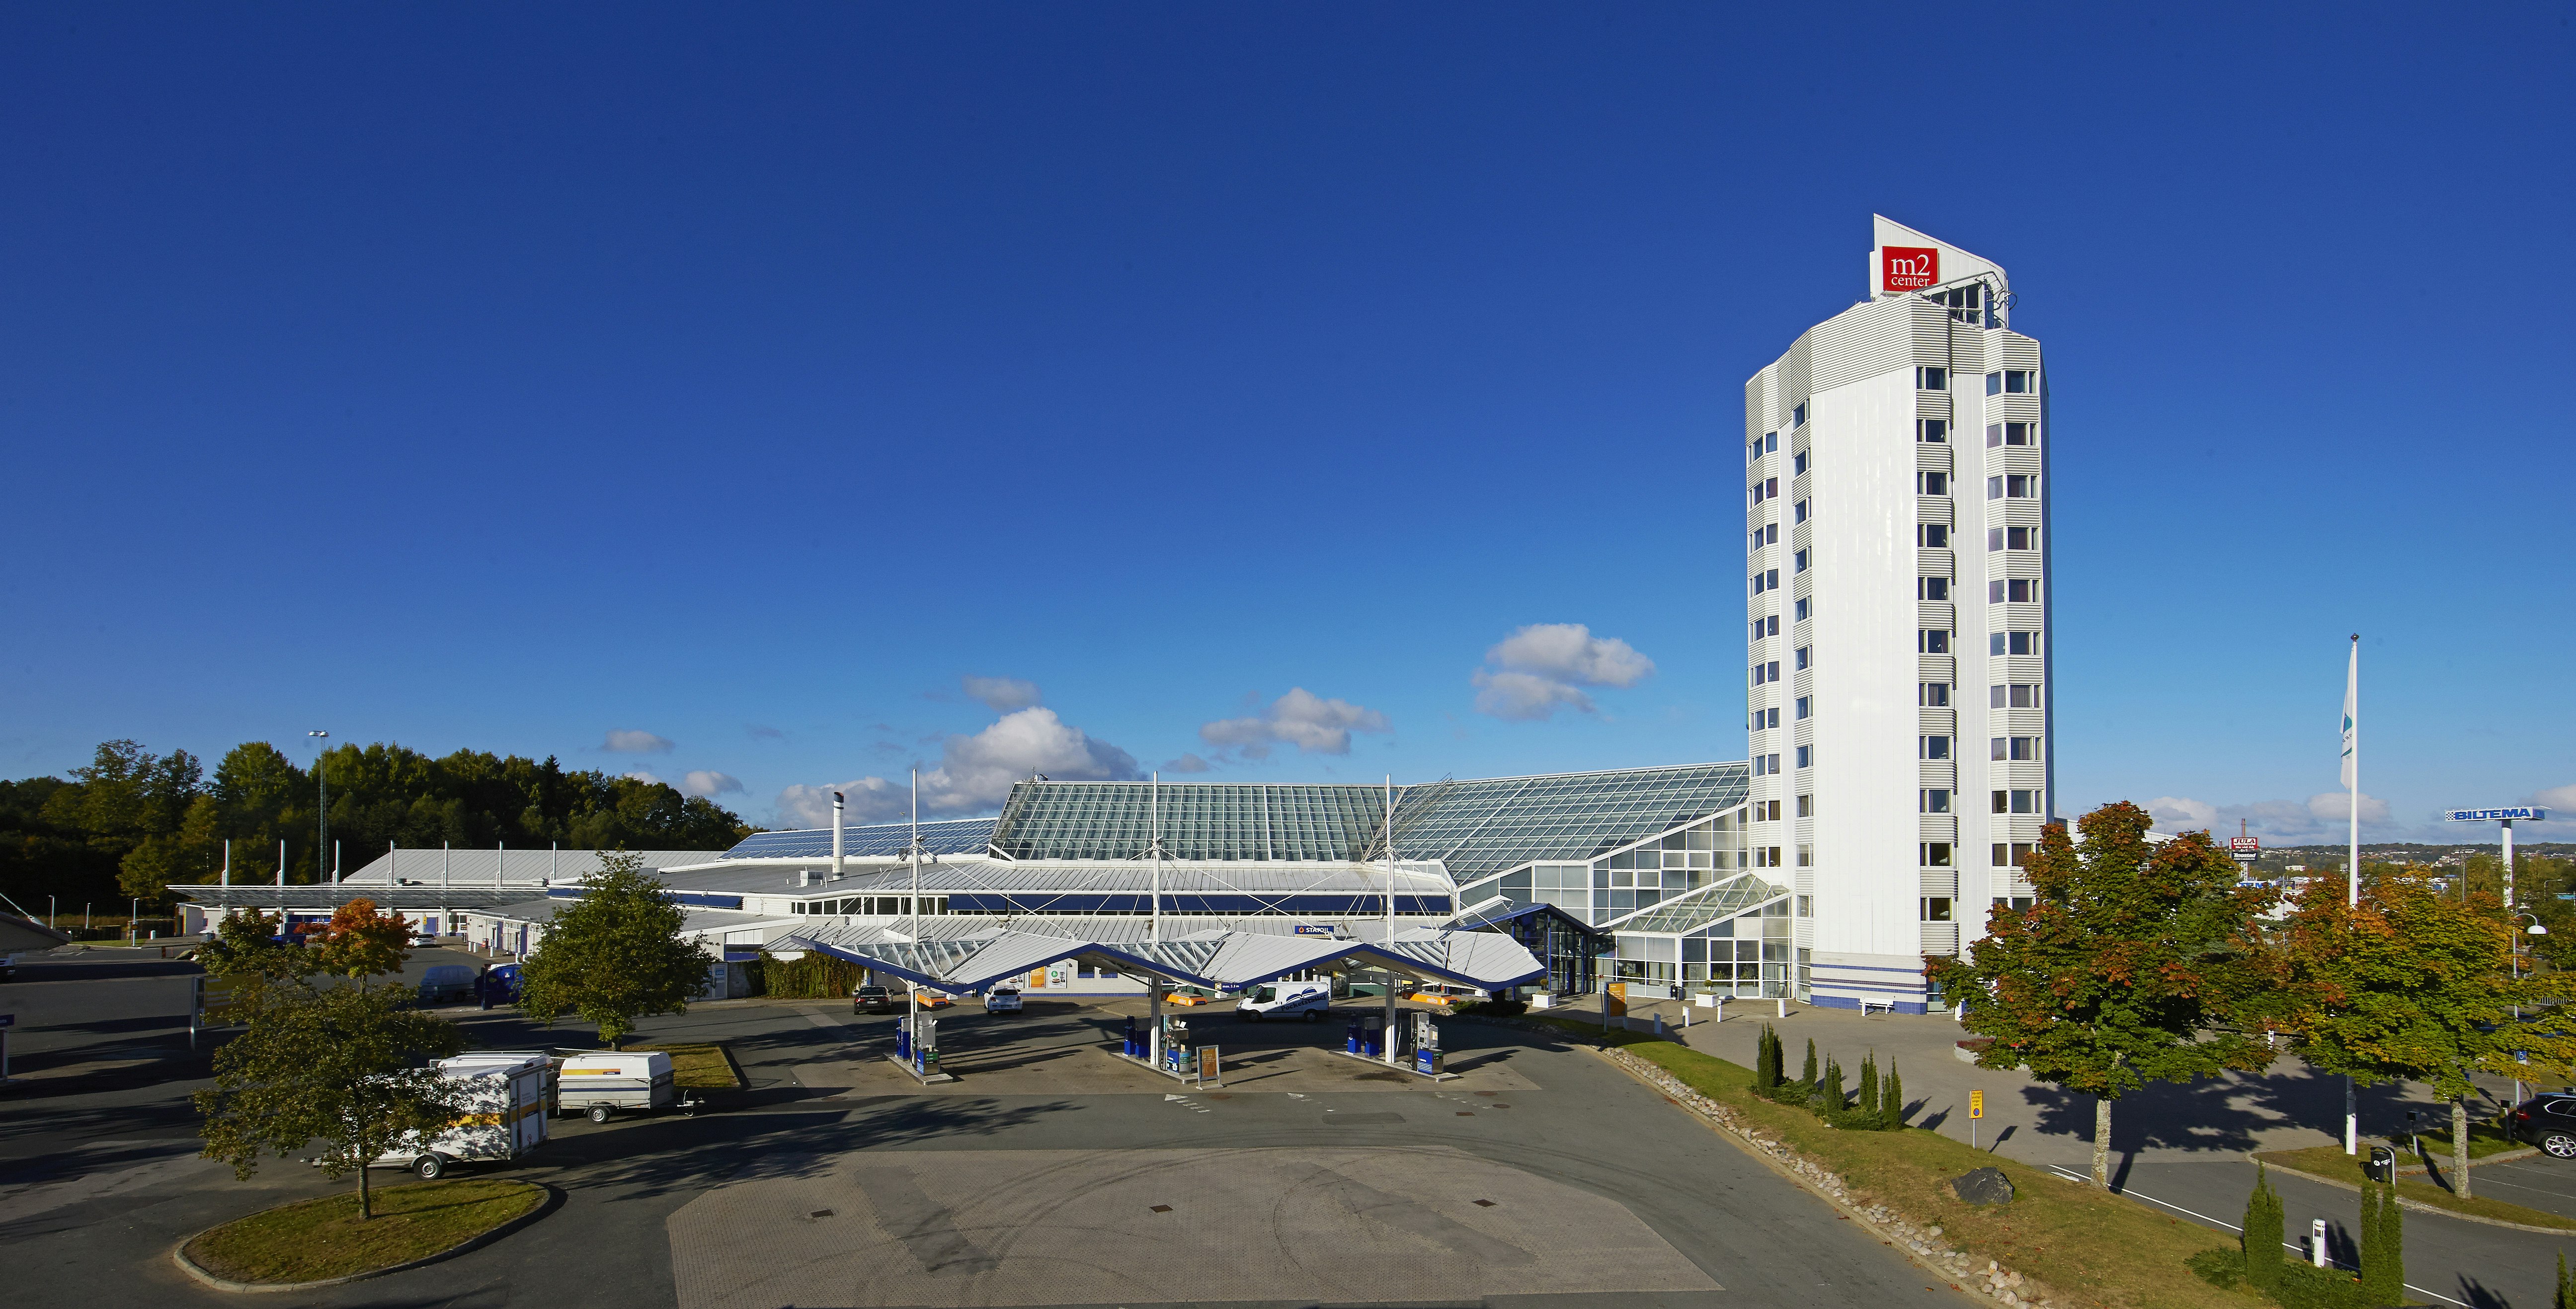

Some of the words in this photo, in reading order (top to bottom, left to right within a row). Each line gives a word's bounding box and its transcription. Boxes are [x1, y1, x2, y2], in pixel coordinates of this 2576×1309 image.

[1891, 254, 1930, 276] m2
[1891, 276, 1930, 287] center
[2455, 808, 2531, 819] BILTEMA
